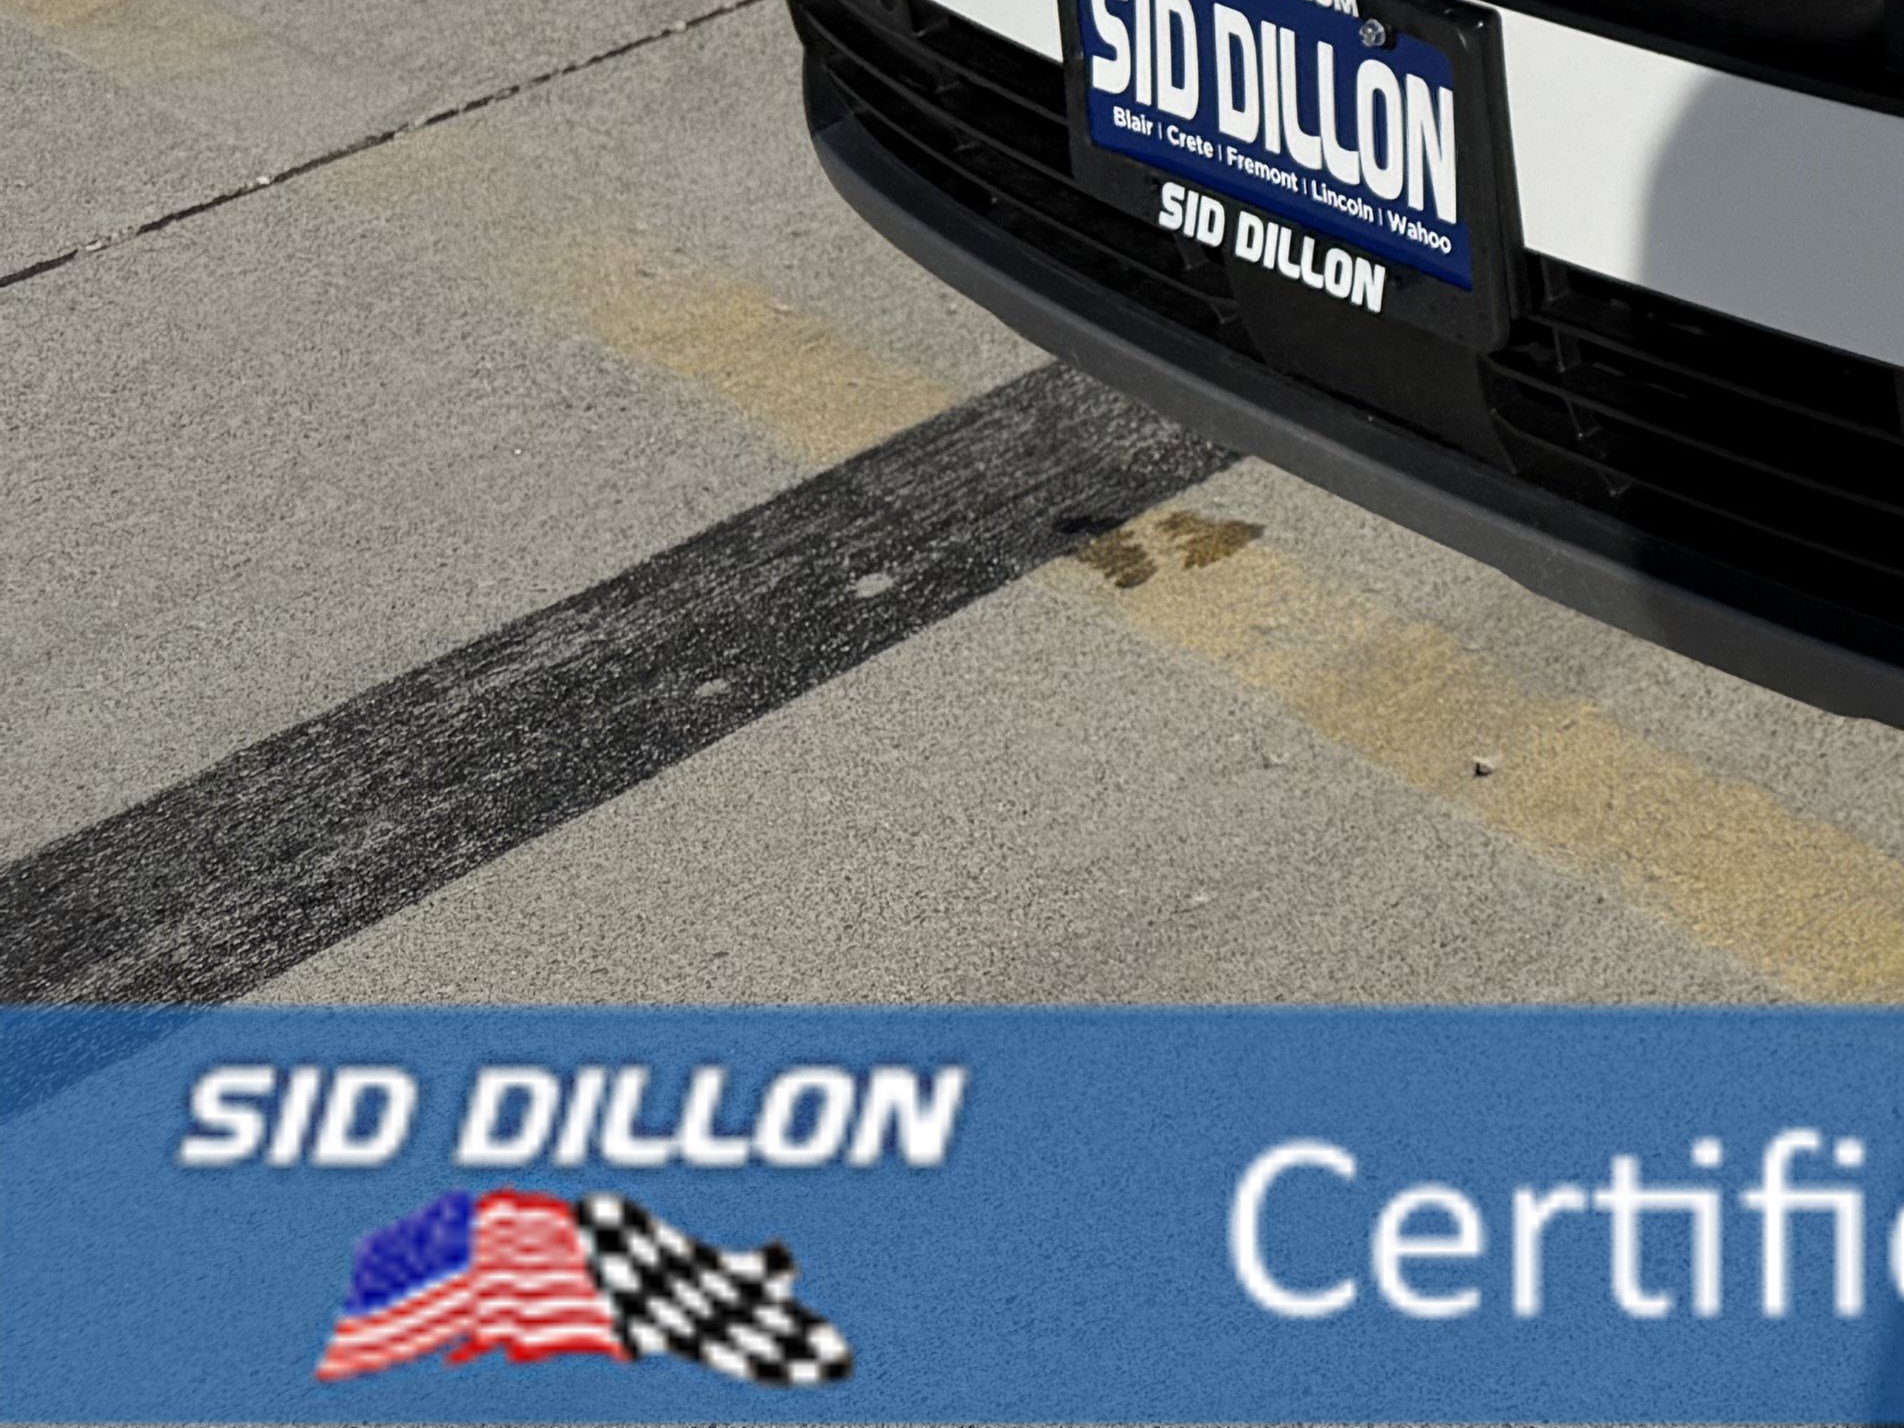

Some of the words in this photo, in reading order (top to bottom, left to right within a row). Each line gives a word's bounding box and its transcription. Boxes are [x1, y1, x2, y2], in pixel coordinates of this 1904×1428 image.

[1113, 105, 1153, 137] Blair
[1167, 125, 1214, 159] Crete
[1226, 147, 1299, 192] Fremont
[1311, 183, 1374, 223] Lincoln
[1388, 211, 1452, 255] Wahoo
[1213, 2, 1457, 225] DILLON
[1157, 180, 1226, 248] SID
[1234, 209, 1386, 314] DILLON
